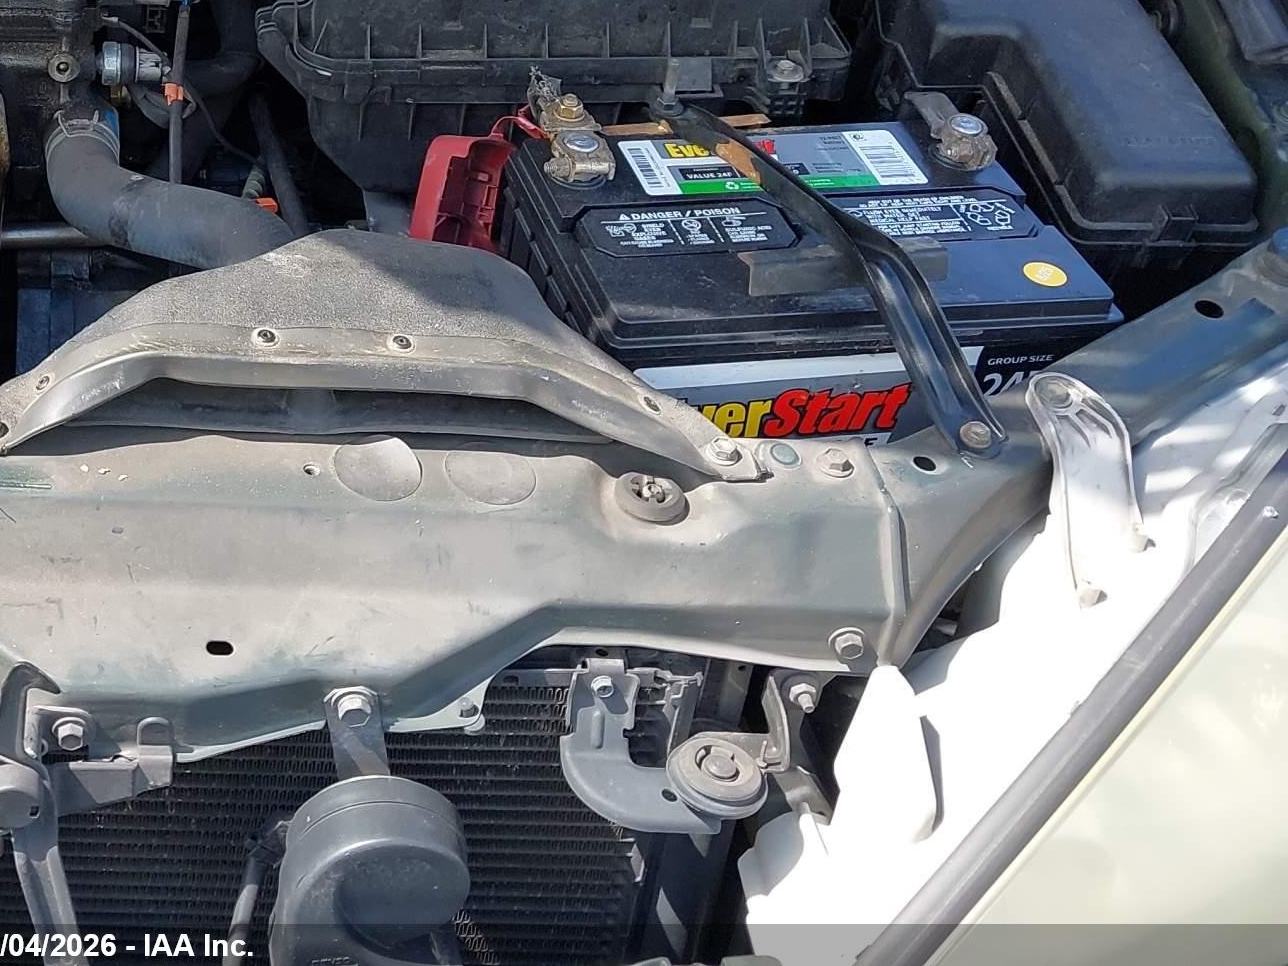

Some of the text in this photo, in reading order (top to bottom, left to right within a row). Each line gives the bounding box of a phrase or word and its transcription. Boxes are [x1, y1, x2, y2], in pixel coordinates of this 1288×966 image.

[685, 171, 715, 180] VALUE
[630, 210, 682, 222] DANGER
[693, 207, 741, 217] POISON
[987, 354, 1054, 366] GROUP SIZE
